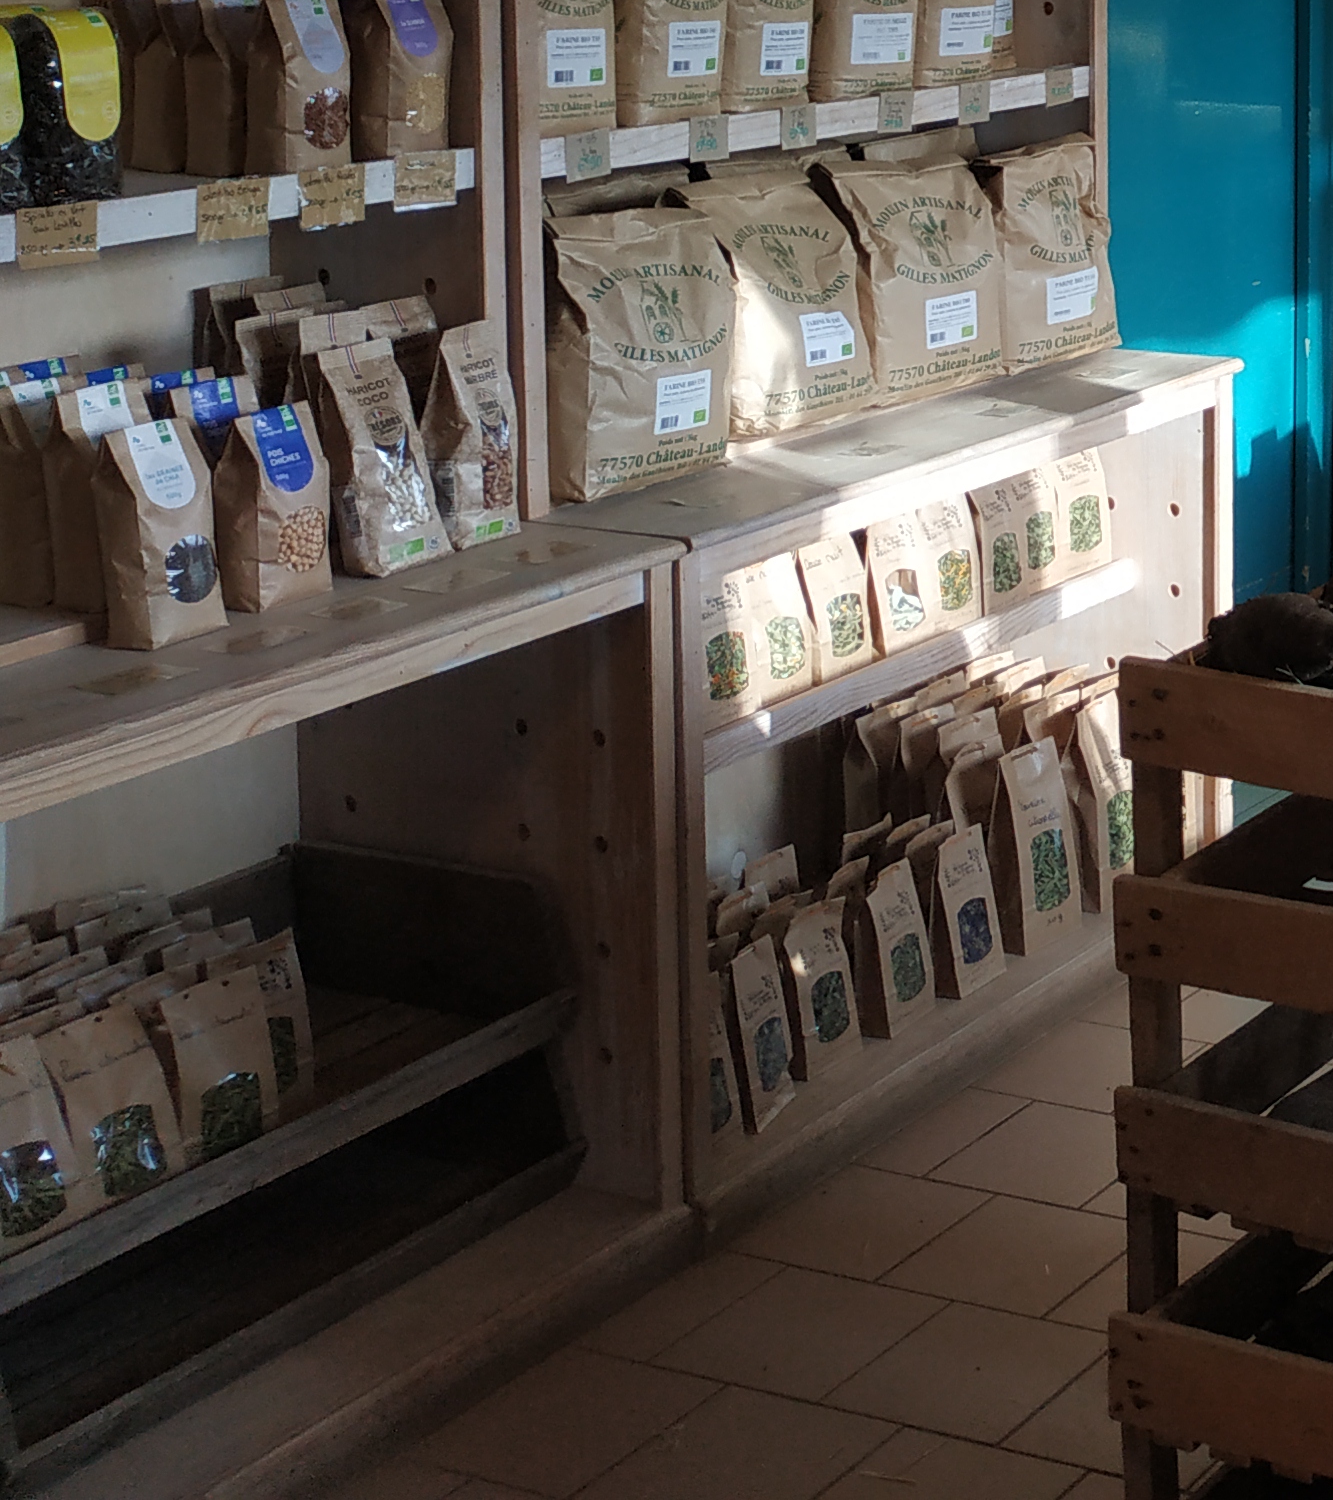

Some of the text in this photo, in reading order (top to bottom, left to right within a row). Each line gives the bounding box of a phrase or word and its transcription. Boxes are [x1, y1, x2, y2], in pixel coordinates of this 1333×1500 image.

[875, 195, 983, 232] MOULIN ARTISANAL
[757, 223, 831, 244] ARTISANAL
[1029, 244, 1066, 263] GILLES
[633, 262, 722, 287] ARTISANAL
[895, 248, 995, 285] GILLES MATIGNON
[766, 281, 802, 305] GILLES
[613, 322, 730, 364] GILLES MATIGNON
[1018, 338, 1053, 355] 77570
[888, 364, 925, 383] 77570
[663, 380, 687, 392] FARINE
[765, 388, 806, 407] 77570
[266, 448, 285, 459] POIS
[599, 436, 726, 472] 77570 Château-Land
